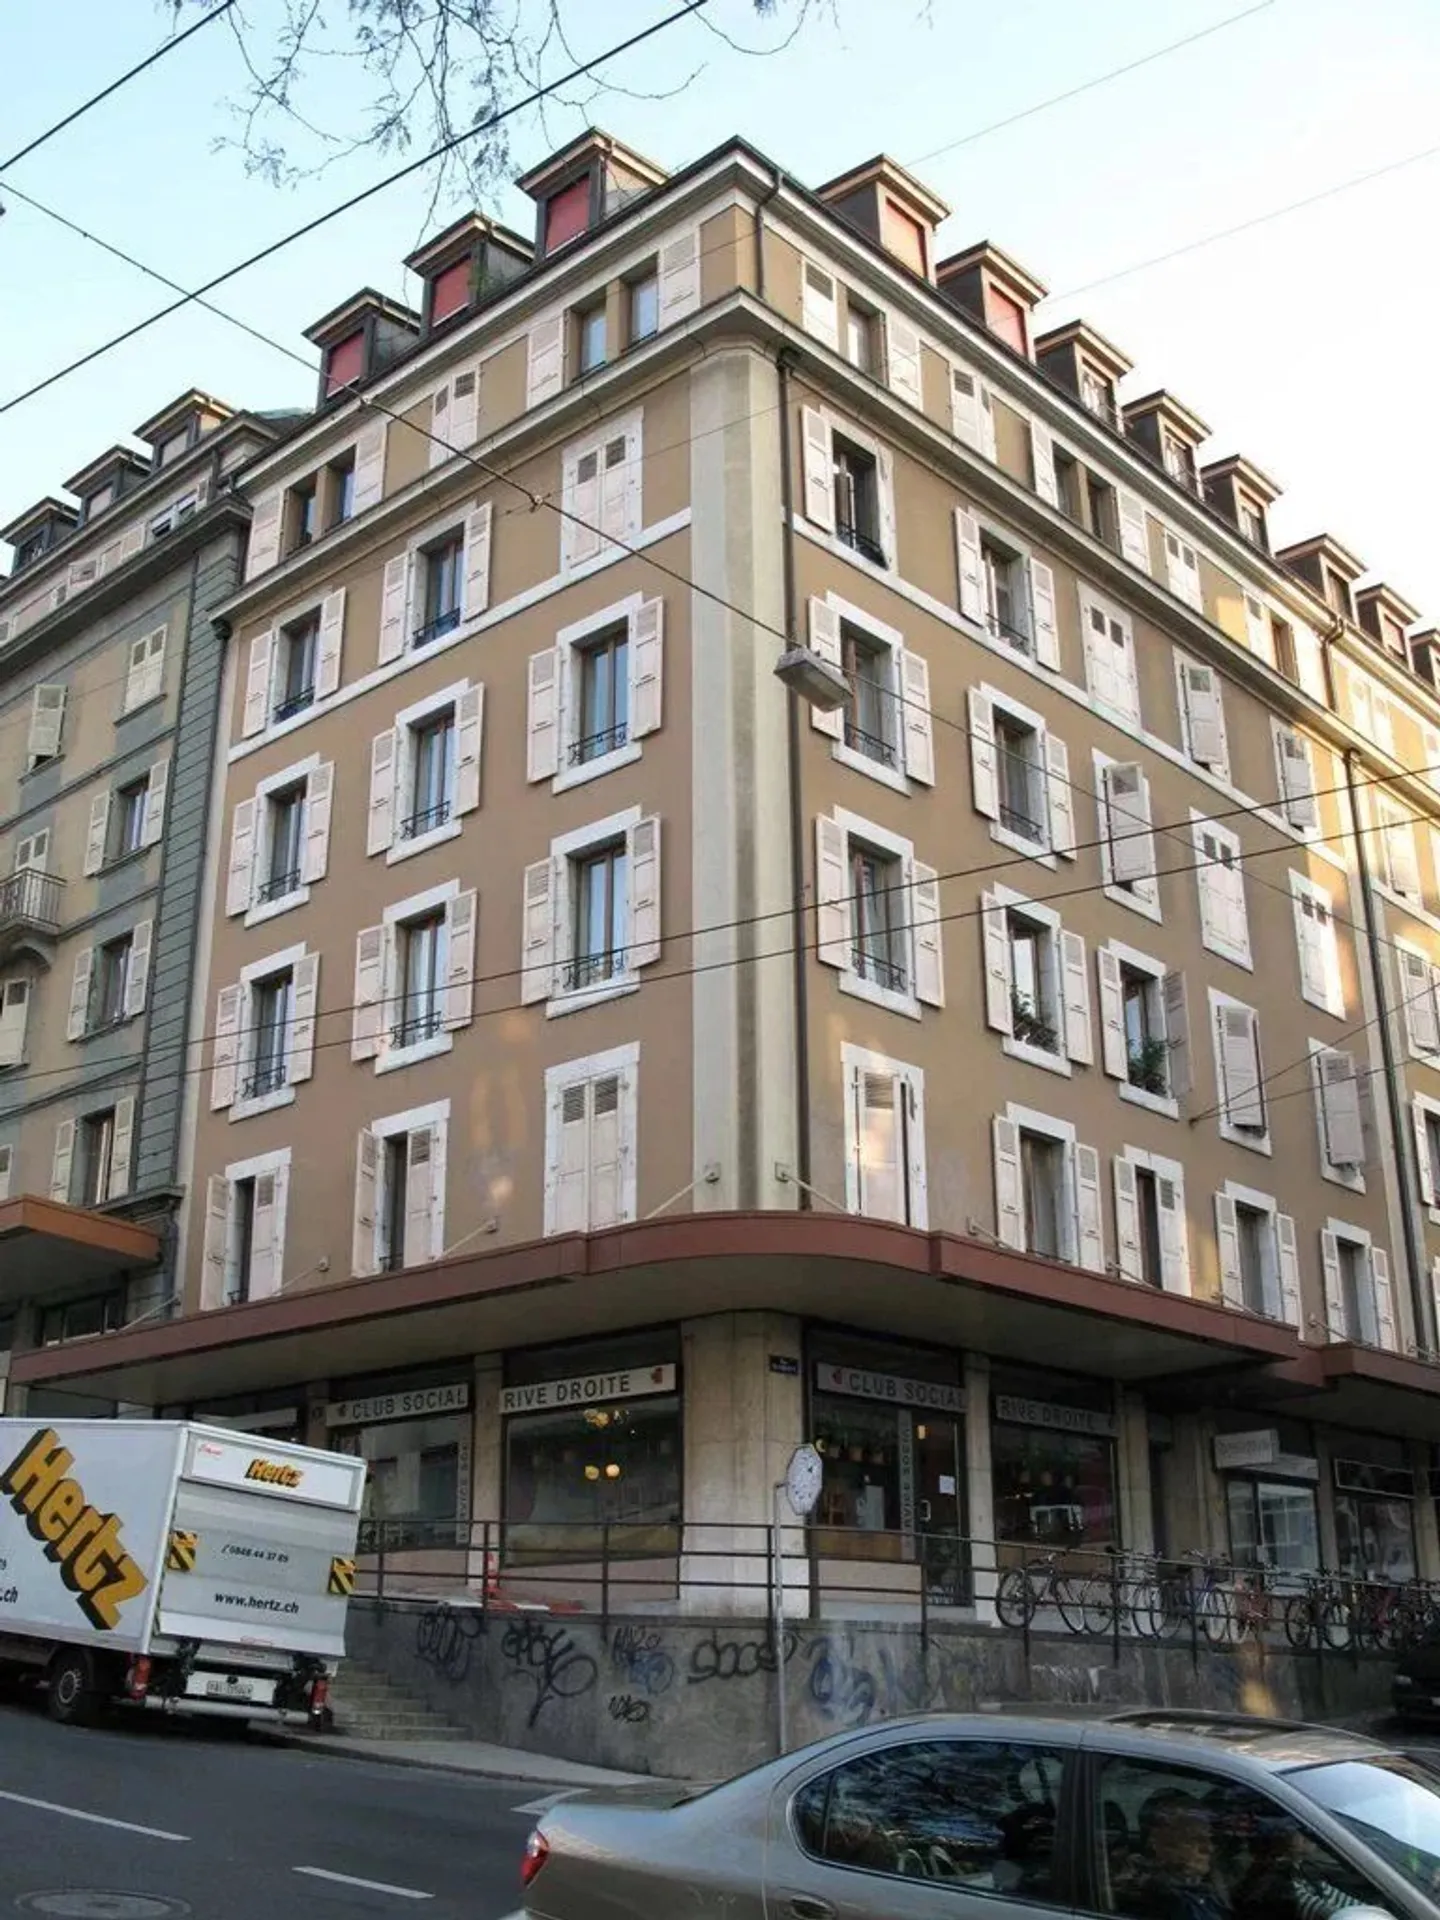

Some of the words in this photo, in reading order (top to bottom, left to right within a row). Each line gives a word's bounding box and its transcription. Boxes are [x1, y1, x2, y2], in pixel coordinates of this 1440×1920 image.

[351, 1397, 395, 1420] CLUB
[402, 1387, 466, 1414] SOCIAL
[503, 1389, 548, 1410] RIVE
[556, 1374, 631, 1401] DROITE
[850, 1373, 897, 1398] CLUB
[903, 1381, 966, 1410] SOCIAL
[1000, 1398, 1038, 1422] RIVE
[1043, 1402, 1096, 1432] DROITE
[245, 1459, 303, 1487] Hertz
[0, 1428, 149, 1630] Hertz
[214, 1592, 299, 1614] www.hertz.ch
